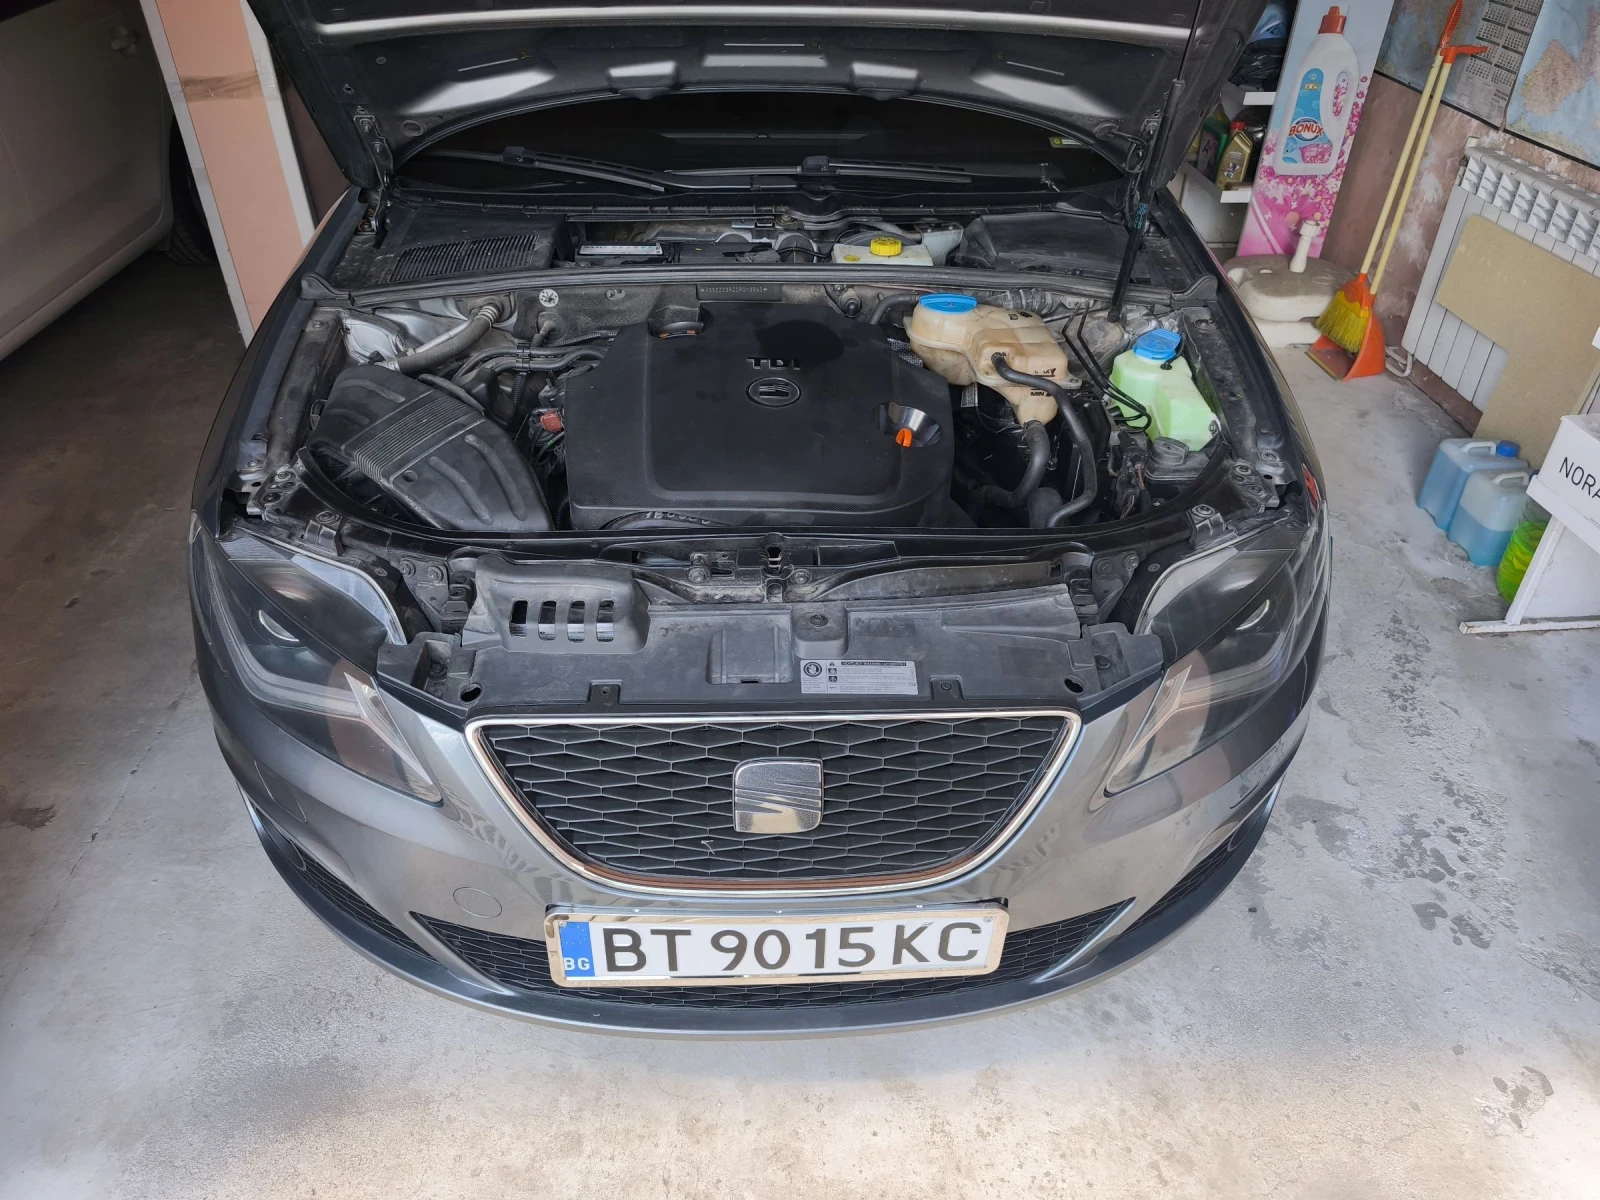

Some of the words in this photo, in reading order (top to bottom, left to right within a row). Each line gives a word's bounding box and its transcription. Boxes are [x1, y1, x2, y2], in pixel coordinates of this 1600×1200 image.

[1288, 121, 1324, 138] BONUX
[746, 357, 800, 370] TDI
[602, 927, 692, 973] BT
[710, 926, 876, 972] 9015
[893, 921, 982, 965] KC
[563, 957, 590, 972] BG
